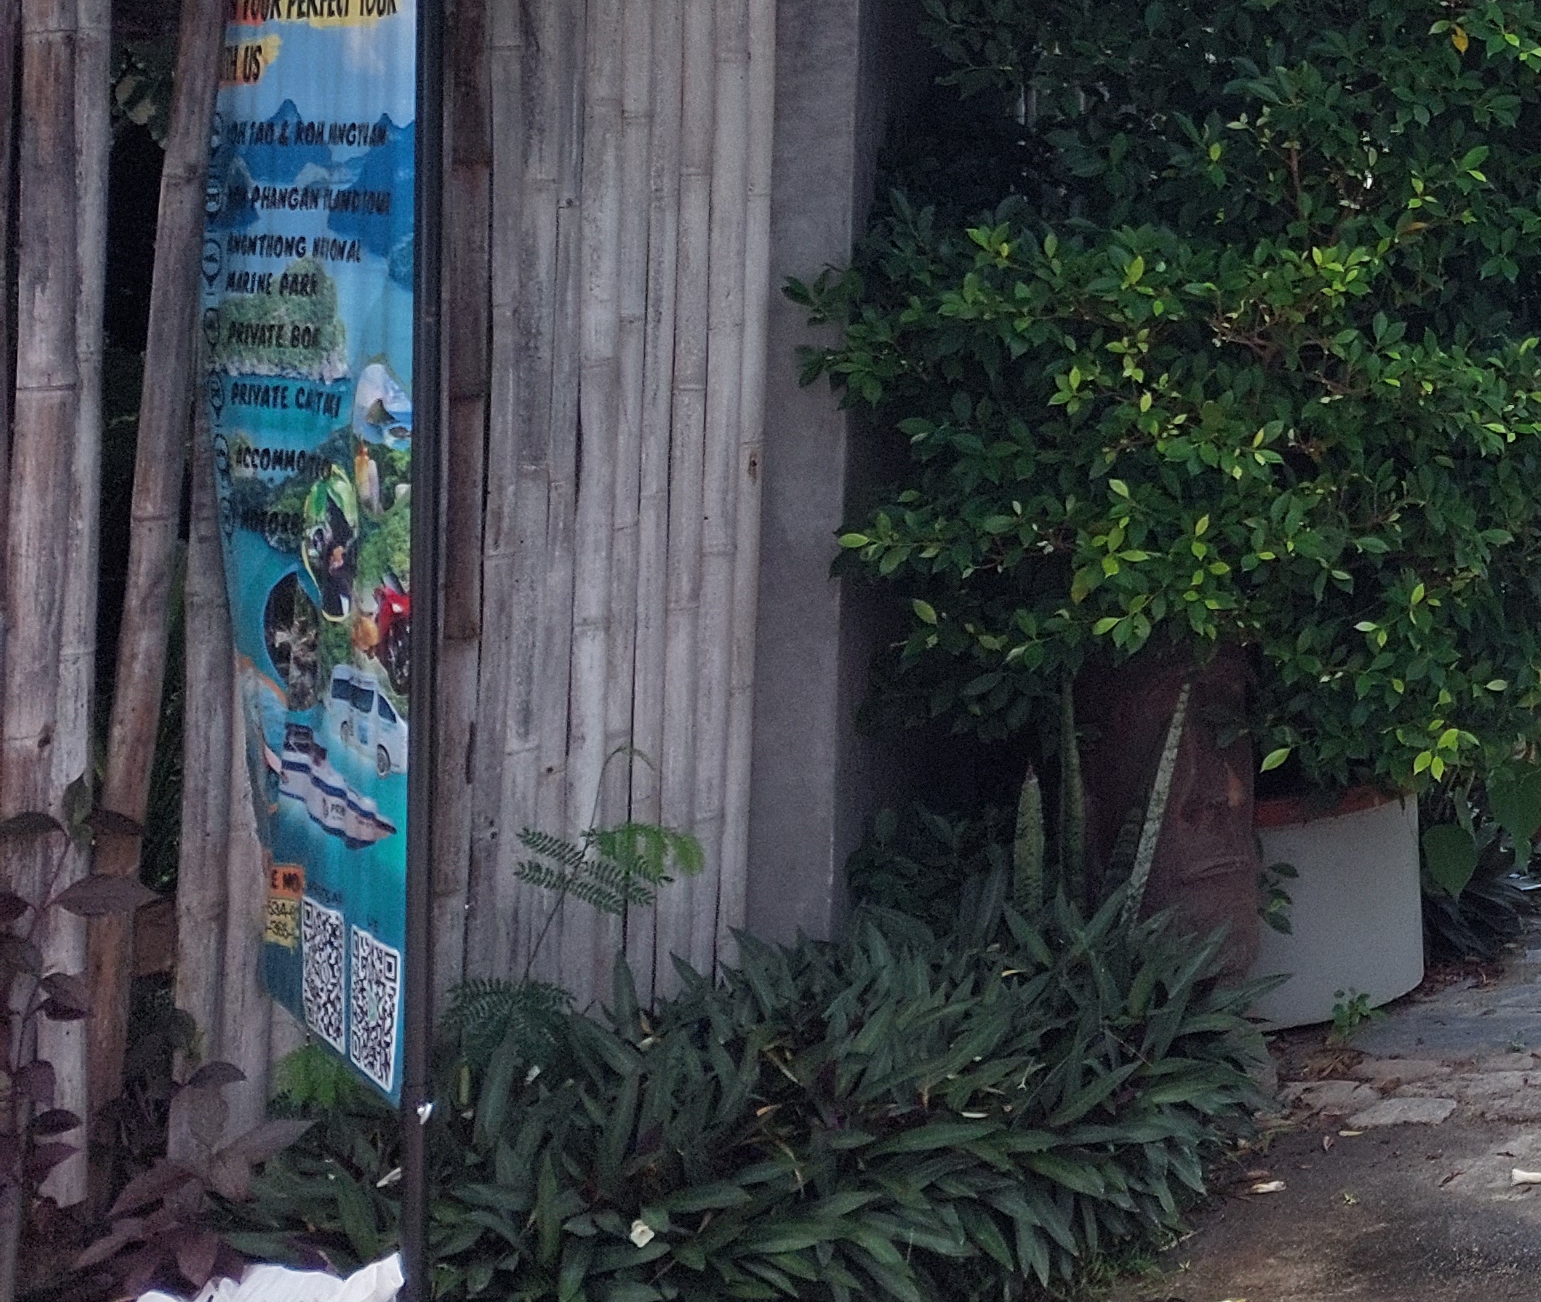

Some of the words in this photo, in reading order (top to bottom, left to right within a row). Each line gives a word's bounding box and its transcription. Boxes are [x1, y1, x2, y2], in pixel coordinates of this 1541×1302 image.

[243, 44, 262, 82] US
[251, 185, 320, 211] PHANGAN
[231, 382, 289, 410] PRIVATE
